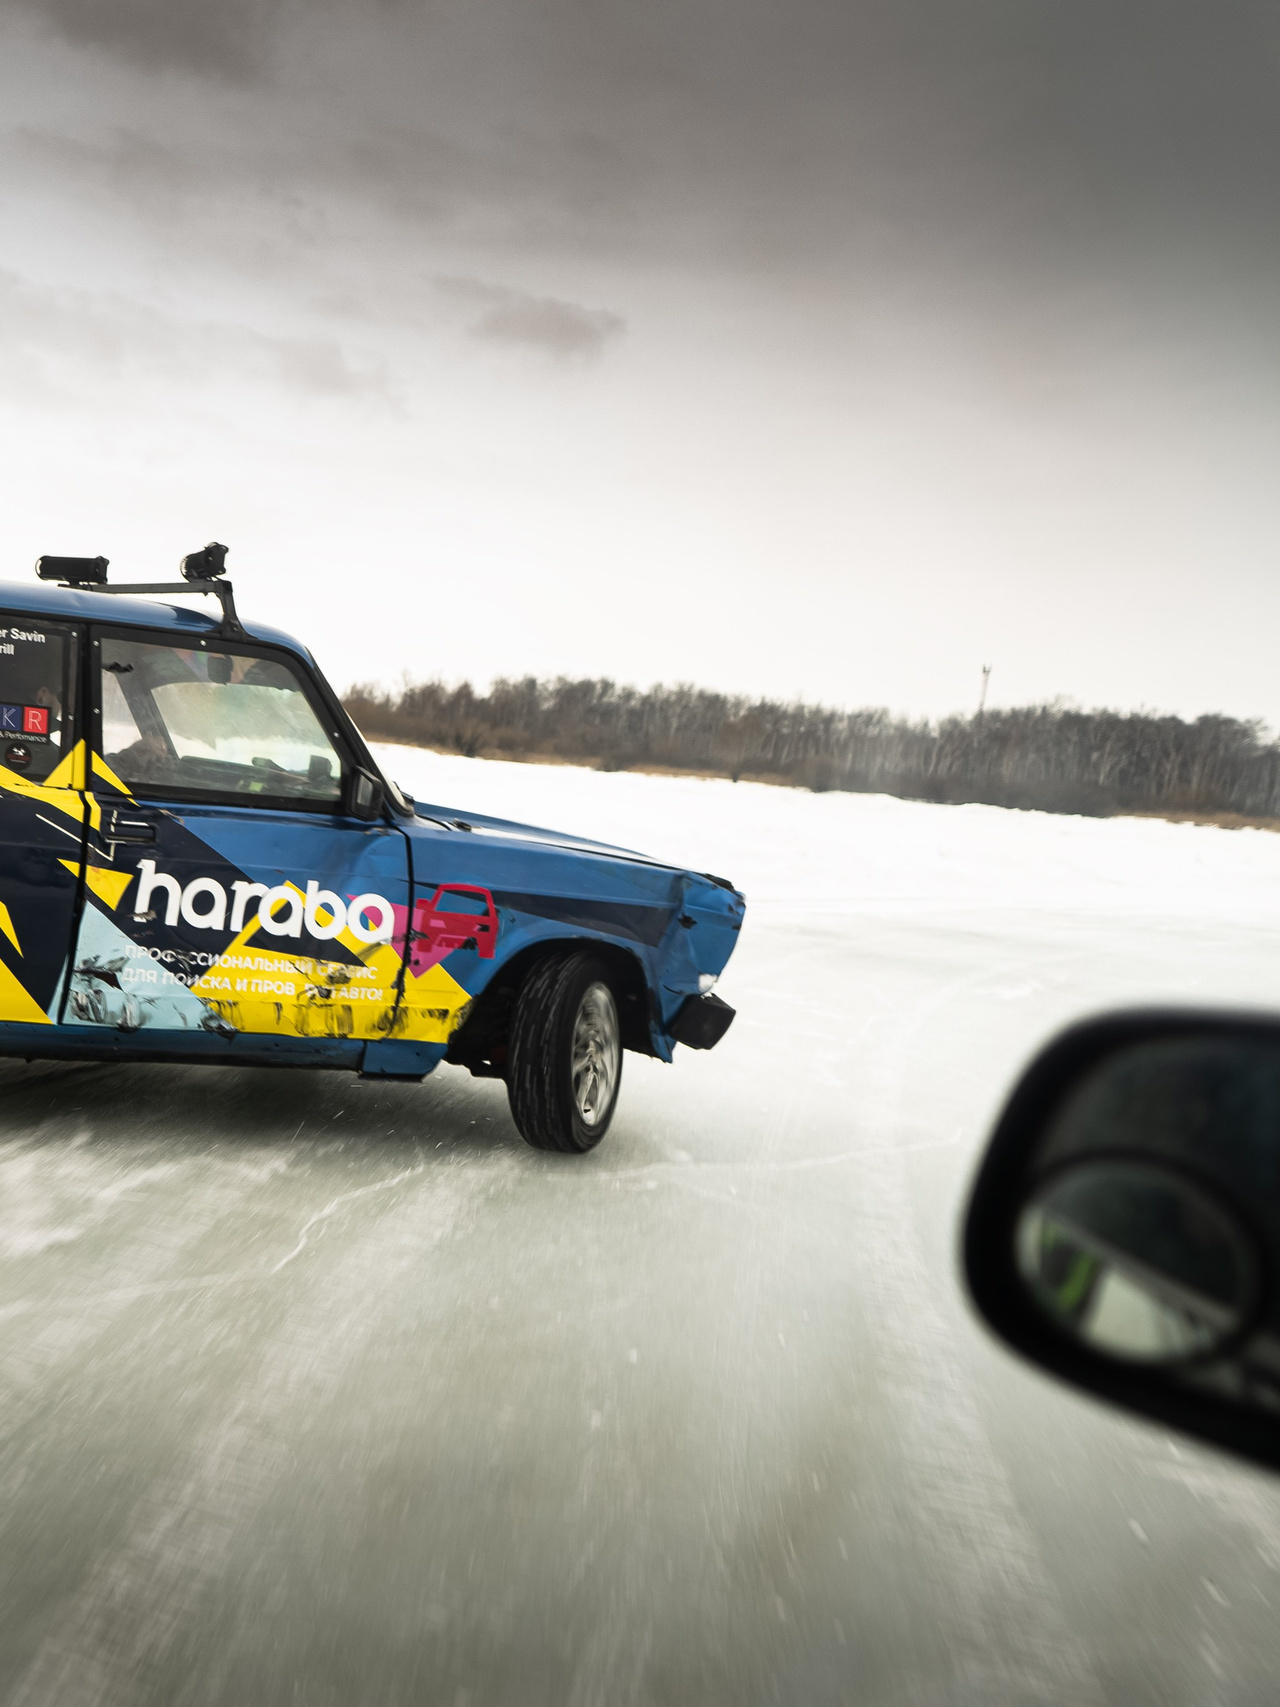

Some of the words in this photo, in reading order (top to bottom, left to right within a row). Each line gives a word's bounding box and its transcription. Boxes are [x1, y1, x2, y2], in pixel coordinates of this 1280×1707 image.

[10, 627, 46, 643] Savin
[134, 858, 396, 943] haraba
[125, 944, 313, 975] ПРОФССИОНАЛЬНЫЙ
[122, 968, 158, 984] ДЛЯ
[161, 972, 232, 991] ПОИСКА
[235, 978, 250, 992] И
[336, 986, 384, 1001] АВТО!
